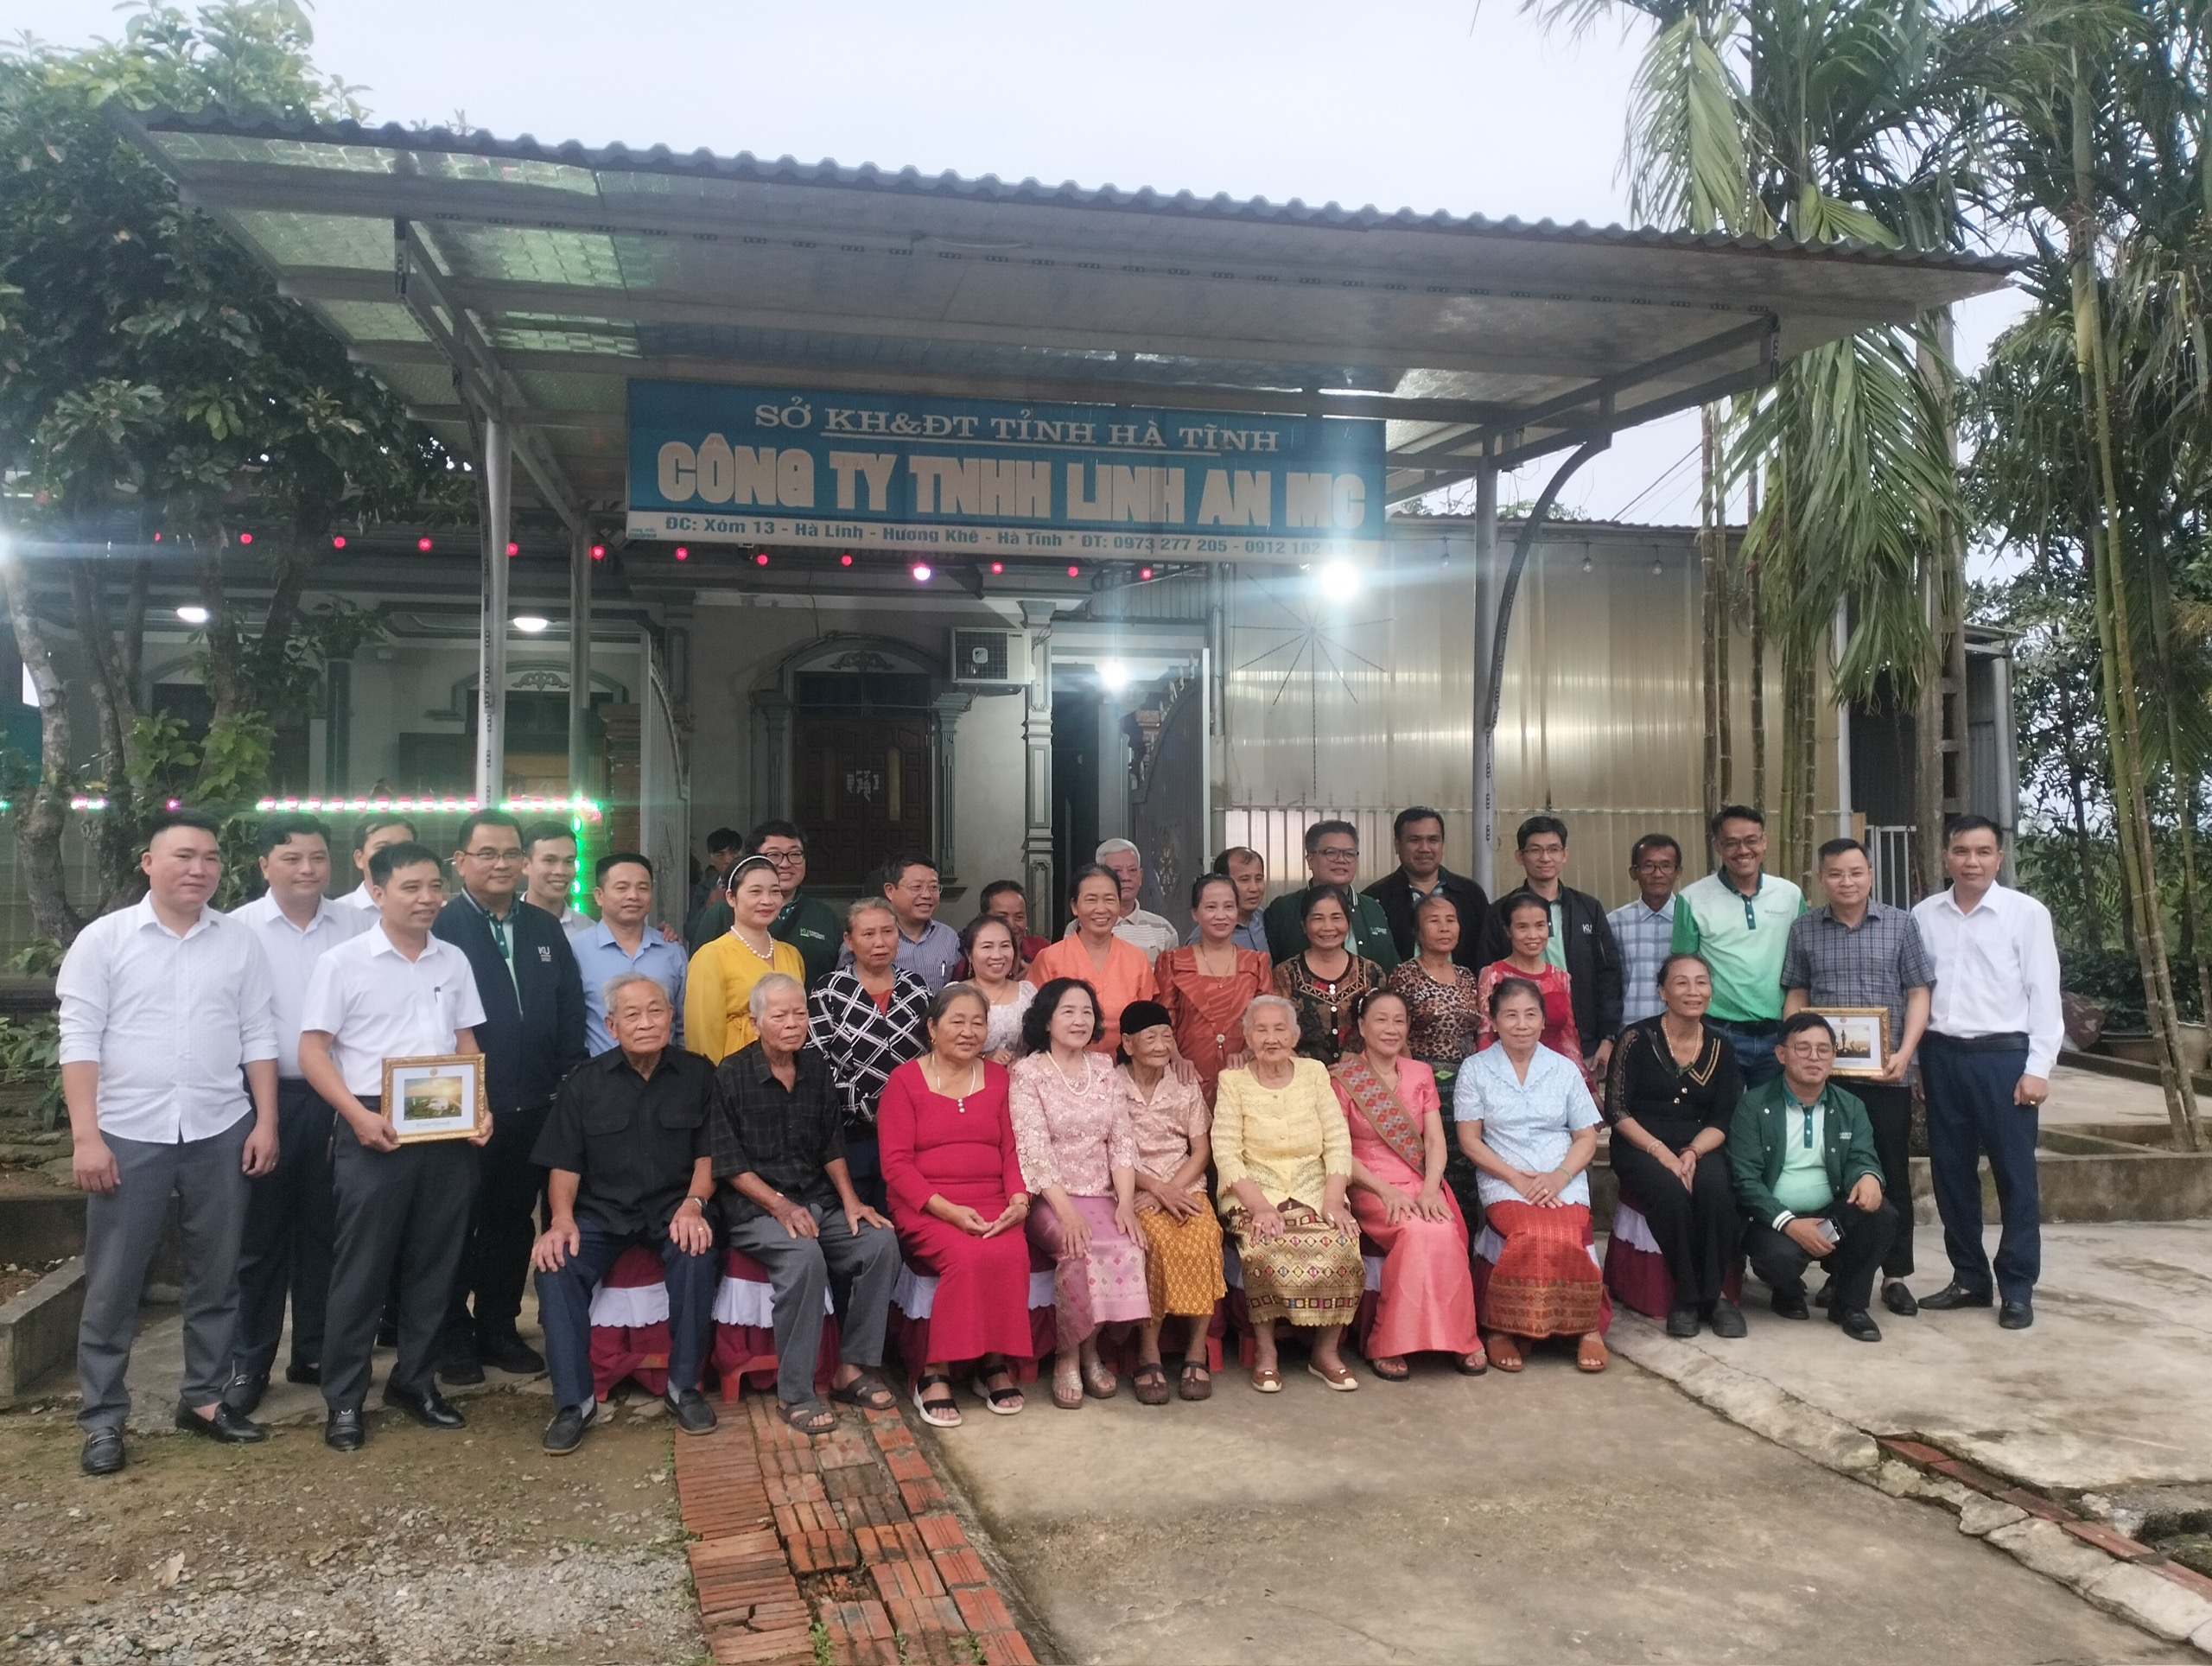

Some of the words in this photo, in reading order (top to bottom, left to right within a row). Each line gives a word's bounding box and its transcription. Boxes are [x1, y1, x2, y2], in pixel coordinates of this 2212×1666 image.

[755, 396, 812, 429] SỞ
[824, 408, 978, 437] KH&ĐT
[991, 409, 1096, 444] TỈNH
[1108, 419, 1166, 447] HÀ
[1179, 423, 1279, 452] TĨNH
[658, 433, 814, 508] CÔNG
[829, 450, 897, 512] TY
[909, 455, 1052, 518] TNHH
[1067, 462, 1185, 524] LINH
[1198, 469, 1271, 525] AN
[1286, 472, 1366, 530] MC
[665, 515, 697, 531] ĐC:
[704, 518, 746, 533] Xóm
[753, 521, 775, 535] 13
[795, 522, 818, 537] Hà
[825, 525, 863, 540] Linh
[883, 526, 939, 543] Hương
[945, 529, 979, 544] Khê
[997, 531, 1020, 544] Hà
[1026, 531, 1063, 546] Tĩnh
[1082, 534, 1108, 549] ĐT:
[1113, 536, 1155, 550] 0973
[1160, 538, 1191, 551] 277
[1197, 539, 1228, 552] 205
[1245, 540, 1286, 555] 0912
[537, 946, 550, 955] KU
